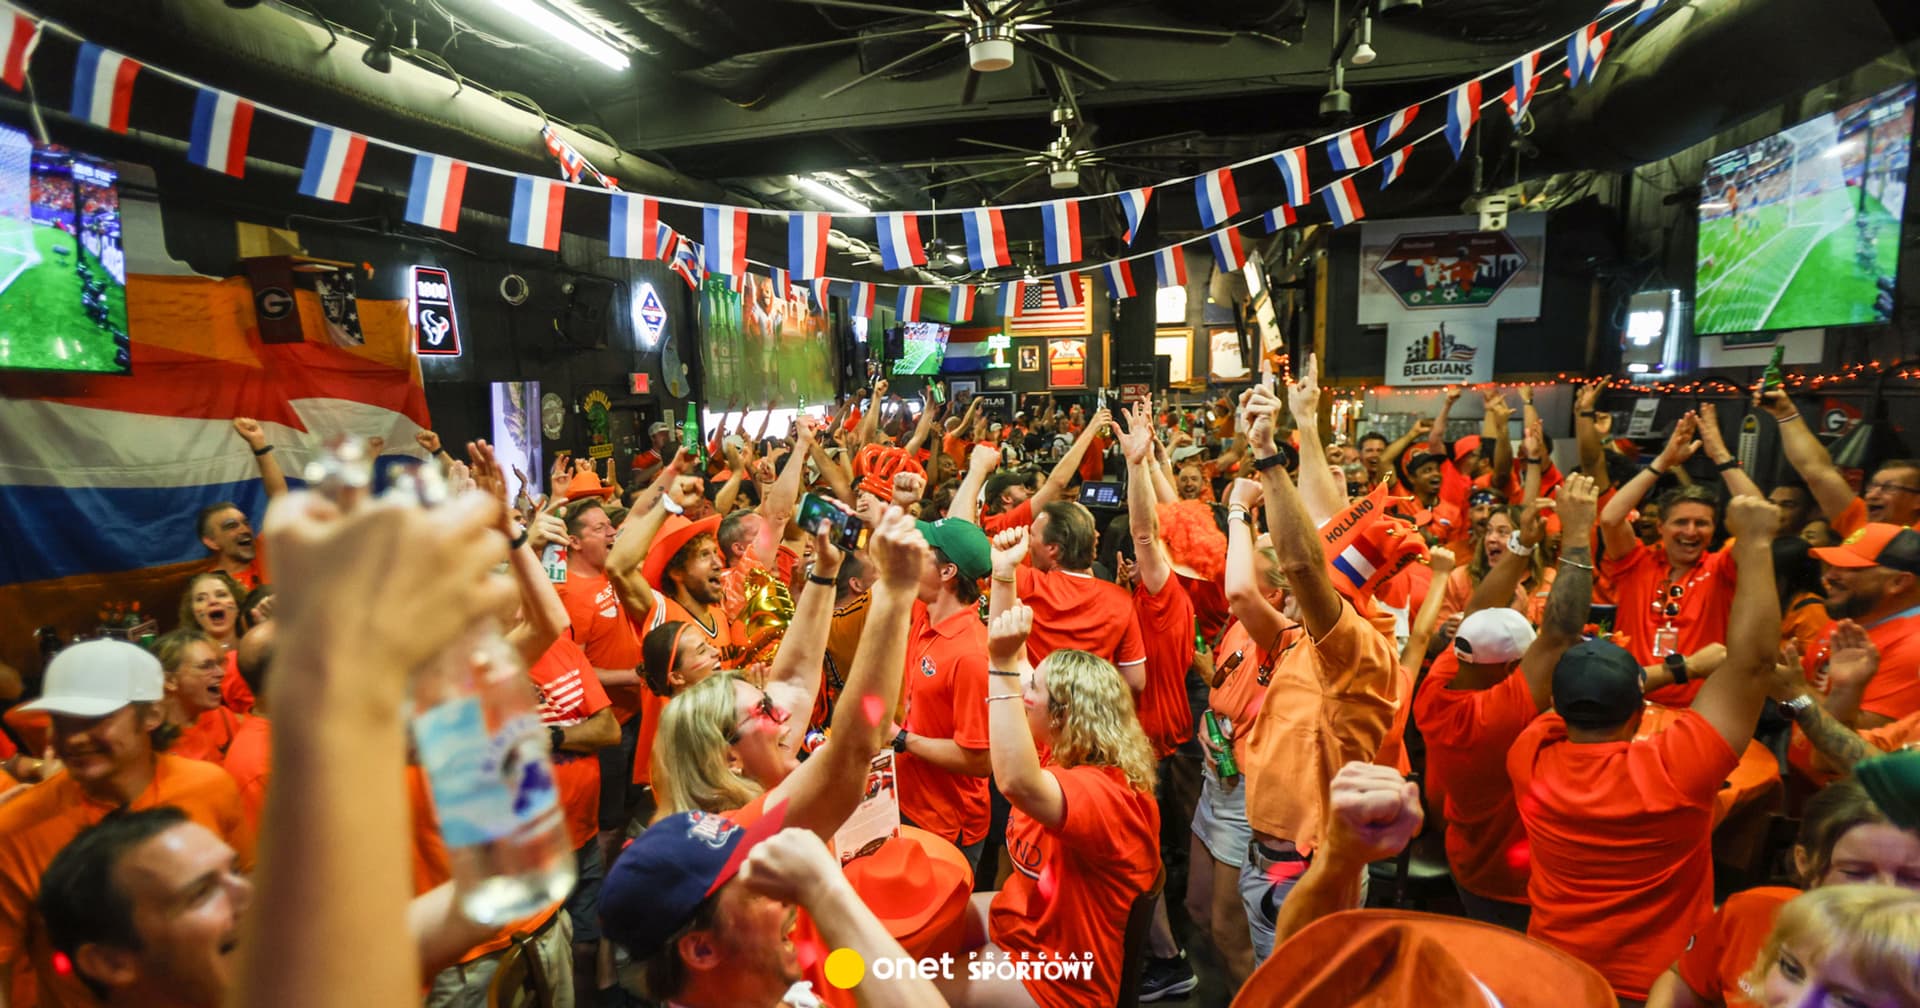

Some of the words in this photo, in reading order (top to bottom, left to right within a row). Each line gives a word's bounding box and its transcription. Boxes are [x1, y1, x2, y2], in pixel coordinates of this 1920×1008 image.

[1403, 362, 1473, 377] BELGIANS
[984, 398, 1005, 406] TLAS
[1325, 499, 1374, 544] HOLLAND
